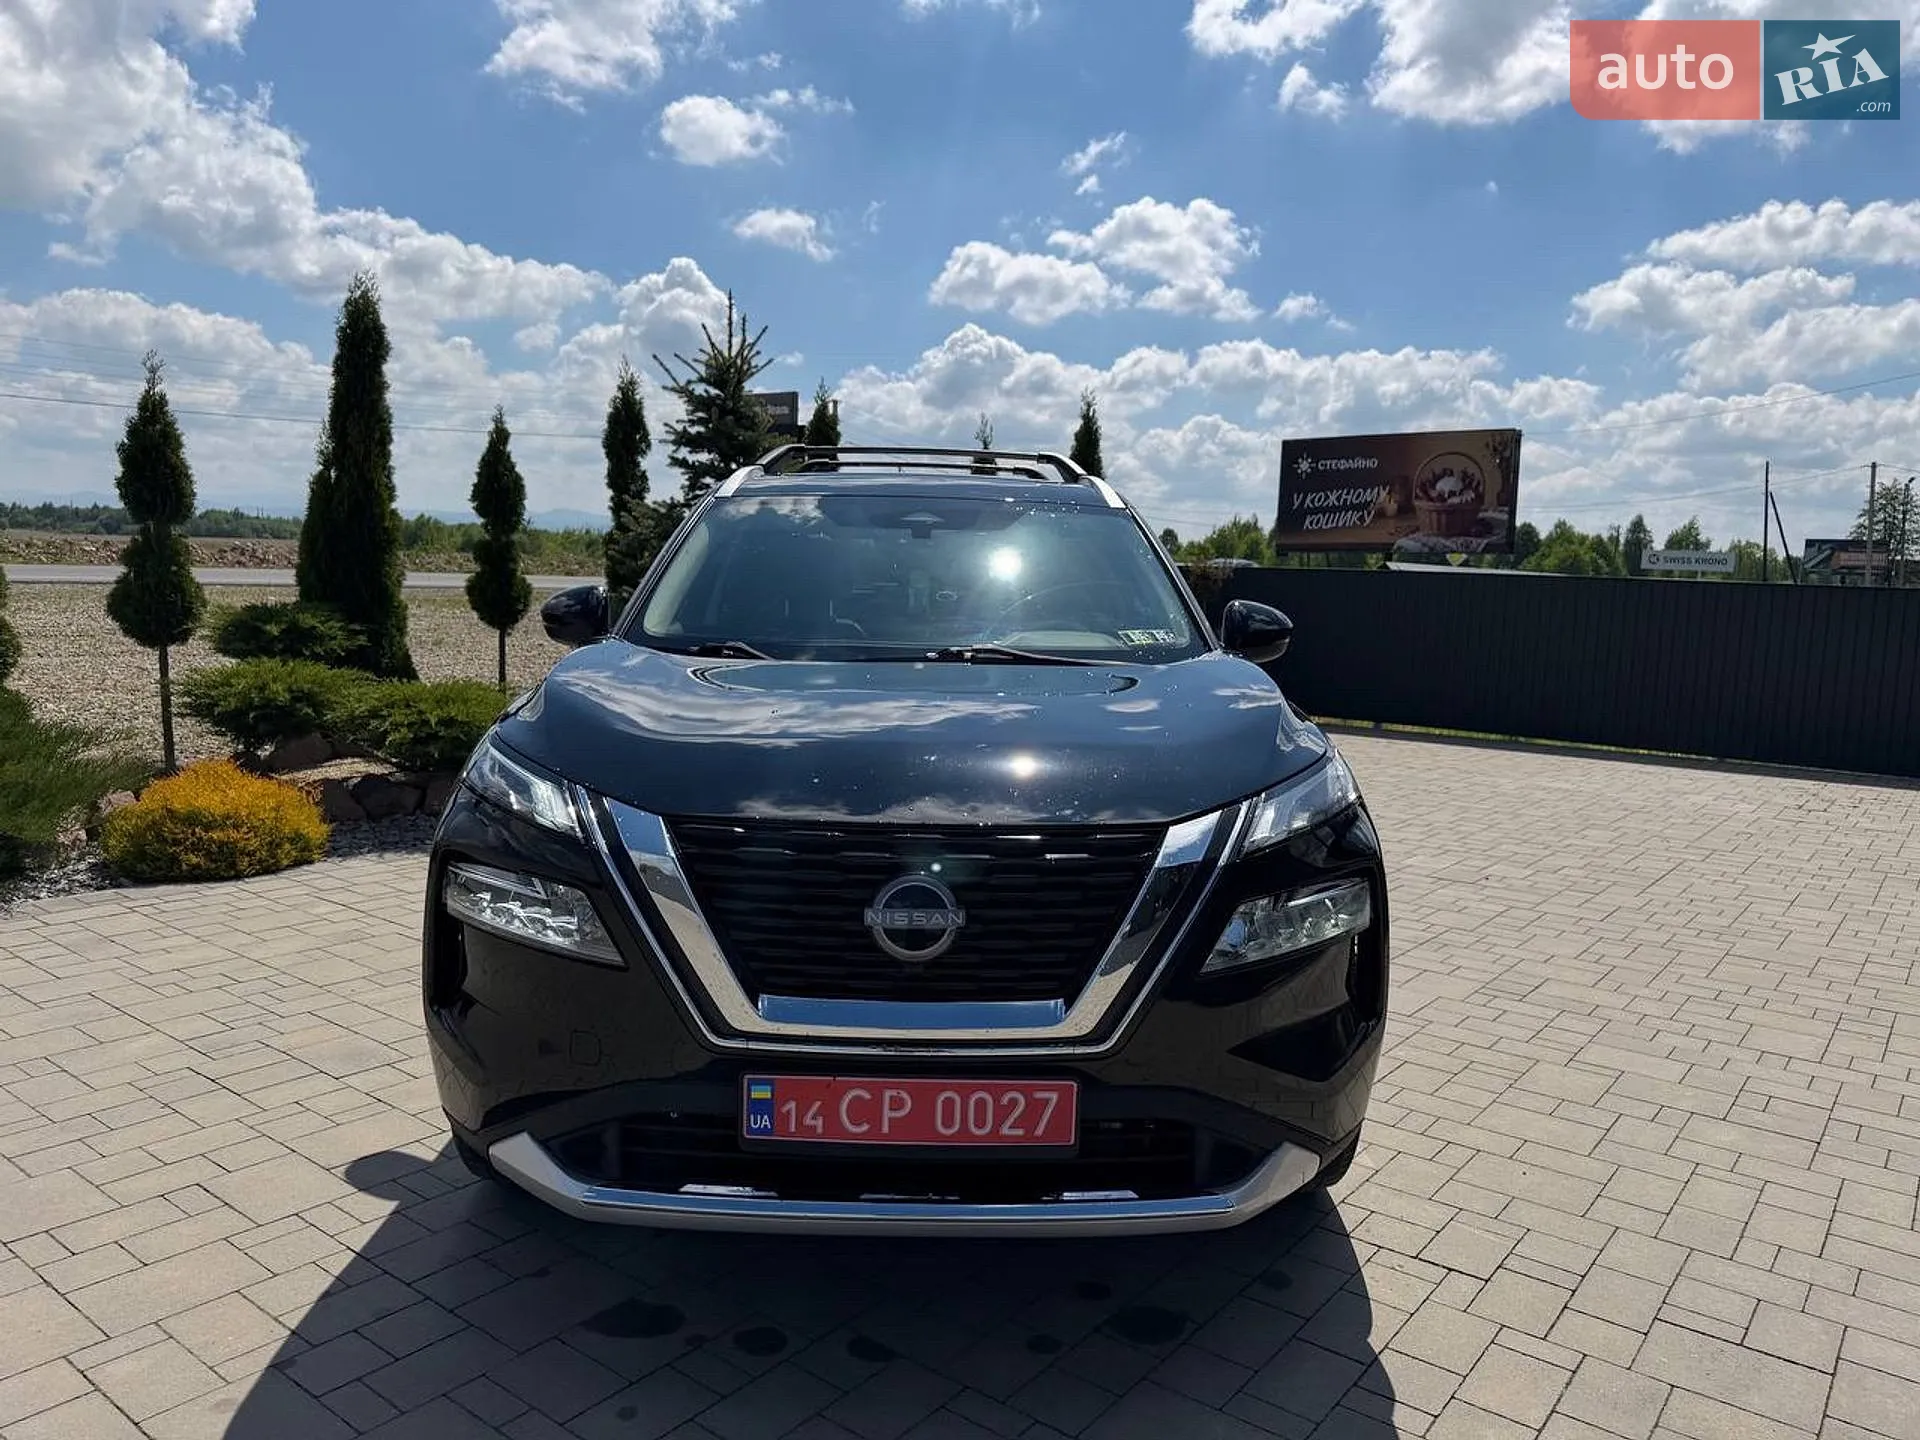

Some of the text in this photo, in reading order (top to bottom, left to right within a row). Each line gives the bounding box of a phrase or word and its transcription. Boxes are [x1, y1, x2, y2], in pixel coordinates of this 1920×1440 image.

[1317, 456, 1379, 470] СТЕФАЙНО
[1303, 484, 1390, 509] КОЖНОМУ
[1303, 507, 1376, 530] КОШИКУ
[1663, 555, 1728, 566] SWISS KRONO
[866, 910, 964, 926] NISSAN
[779, 1087, 1060, 1138] 14 CP 0027
[750, 1114, 772, 1130] UA
